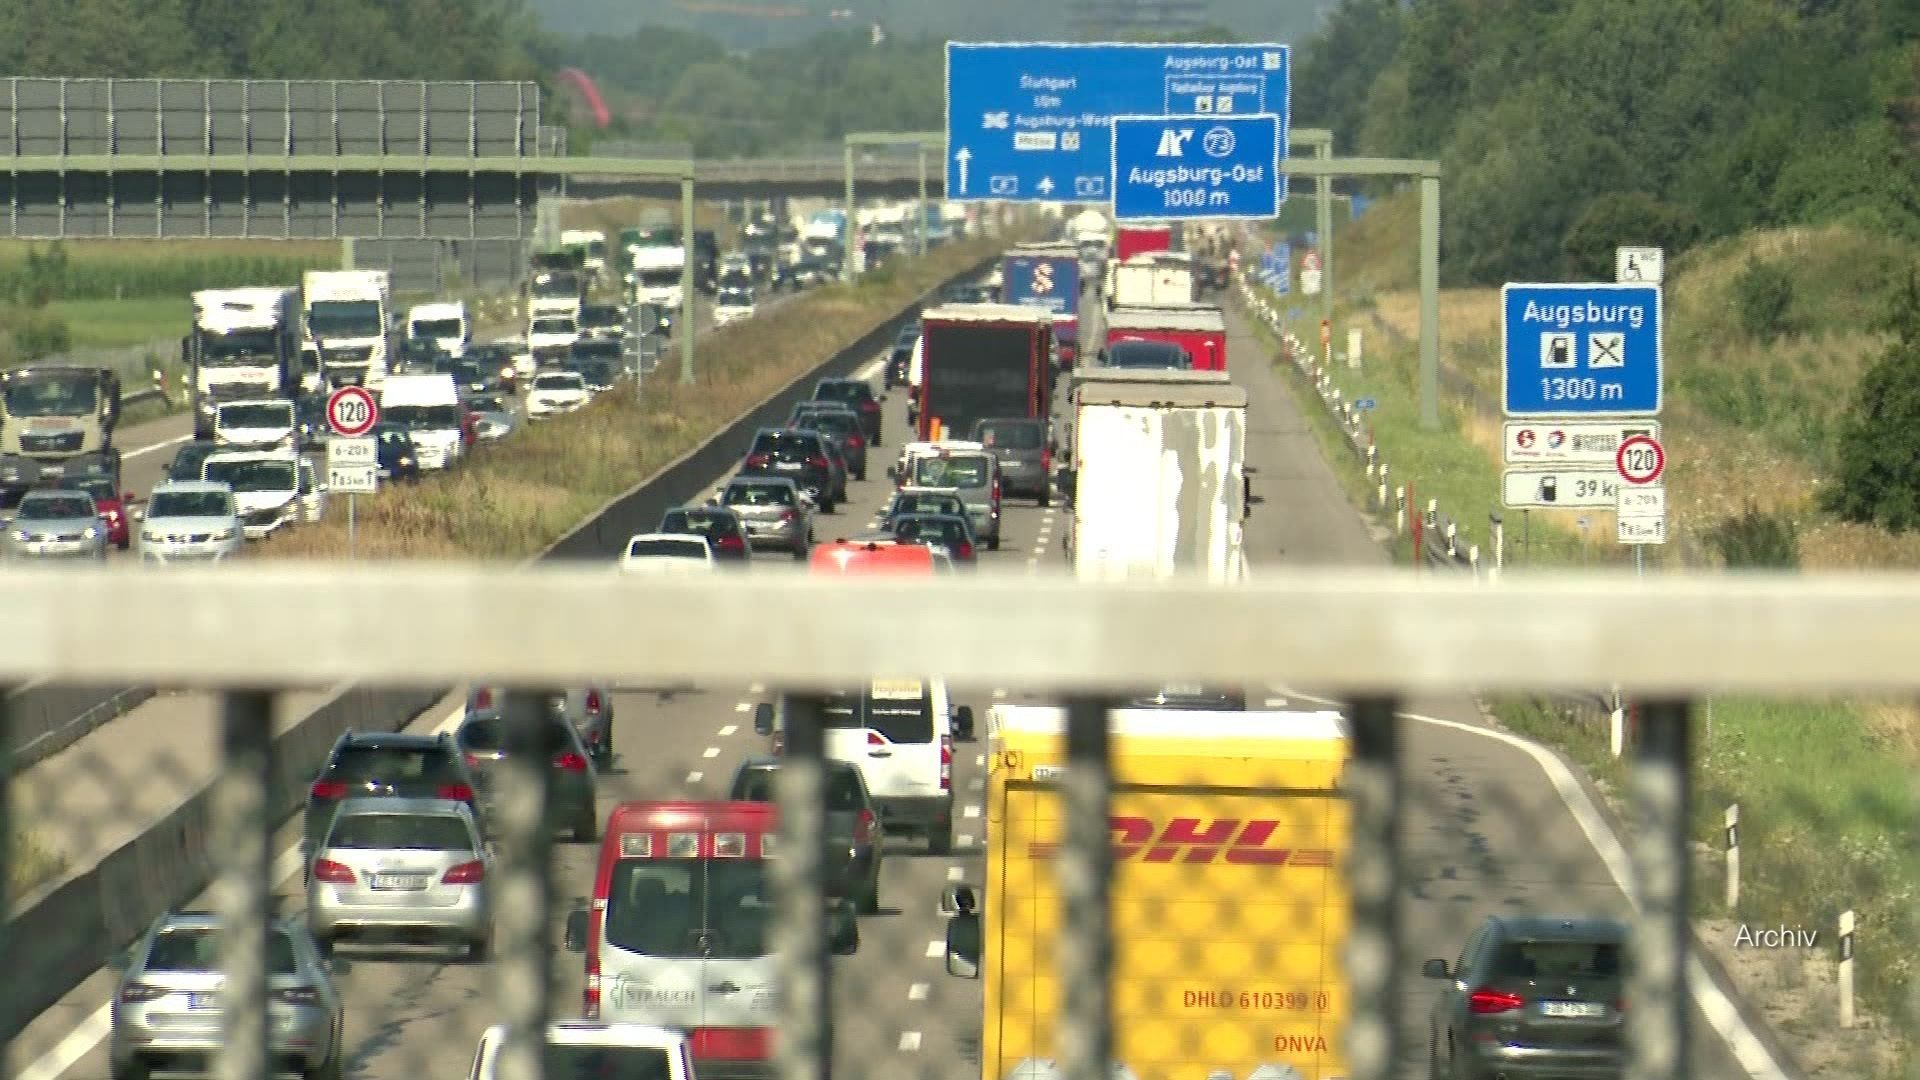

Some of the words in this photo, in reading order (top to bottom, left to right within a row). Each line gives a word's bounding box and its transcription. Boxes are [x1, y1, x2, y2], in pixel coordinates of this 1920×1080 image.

[1164, 55, 1257, 71] Augsburg-Ost
[1020, 74, 1077, 91] Stuttgart
[1014, 113, 1111, 128] Augsburg-Wes
[1208, 134, 1229, 151] 73
[1128, 164, 1264, 188] Augsburg-Ost
[1163, 189, 1206, 207] 1000
[1208, 191, 1230, 206] m
[1523, 300, 1644, 328] Augsburg
[1541, 377, 1597, 400] 1300
[1601, 382, 1623, 399] m
[338, 401, 366, 422] 120
[1625, 449, 1655, 471] 120
[1575, 480, 1597, 497] 39
[1107, 816, 1291, 865] DHL
[626, 989, 695, 1004] STRAUCH
[1239, 992, 1308, 1009] 610399
[1275, 1035, 1327, 1052] DNVA
